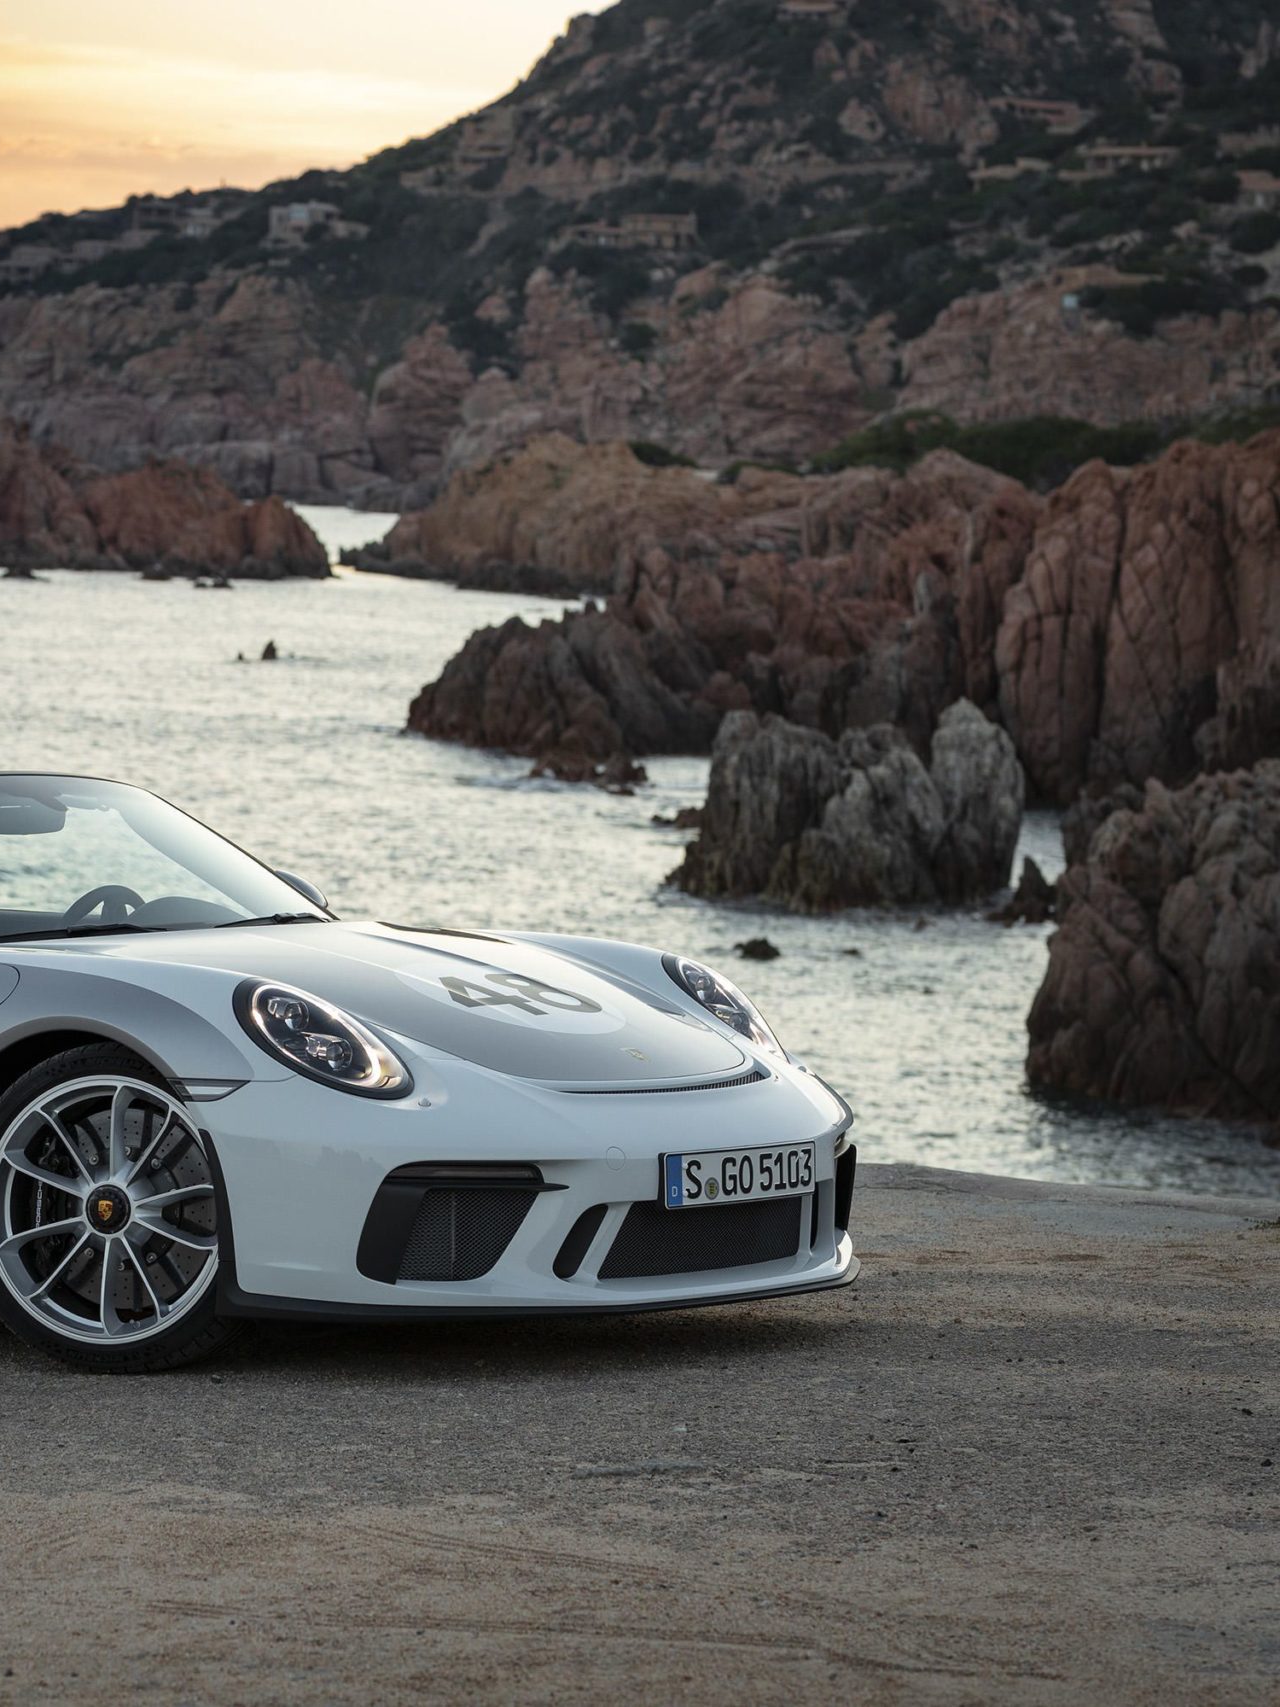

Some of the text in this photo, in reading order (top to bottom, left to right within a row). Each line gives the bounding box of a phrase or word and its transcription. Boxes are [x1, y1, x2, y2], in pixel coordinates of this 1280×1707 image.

[439, 973, 602, 1015] 48
[671, 1186, 679, 1198] D
[685, 1149, 812, 1199] S GO 5103
